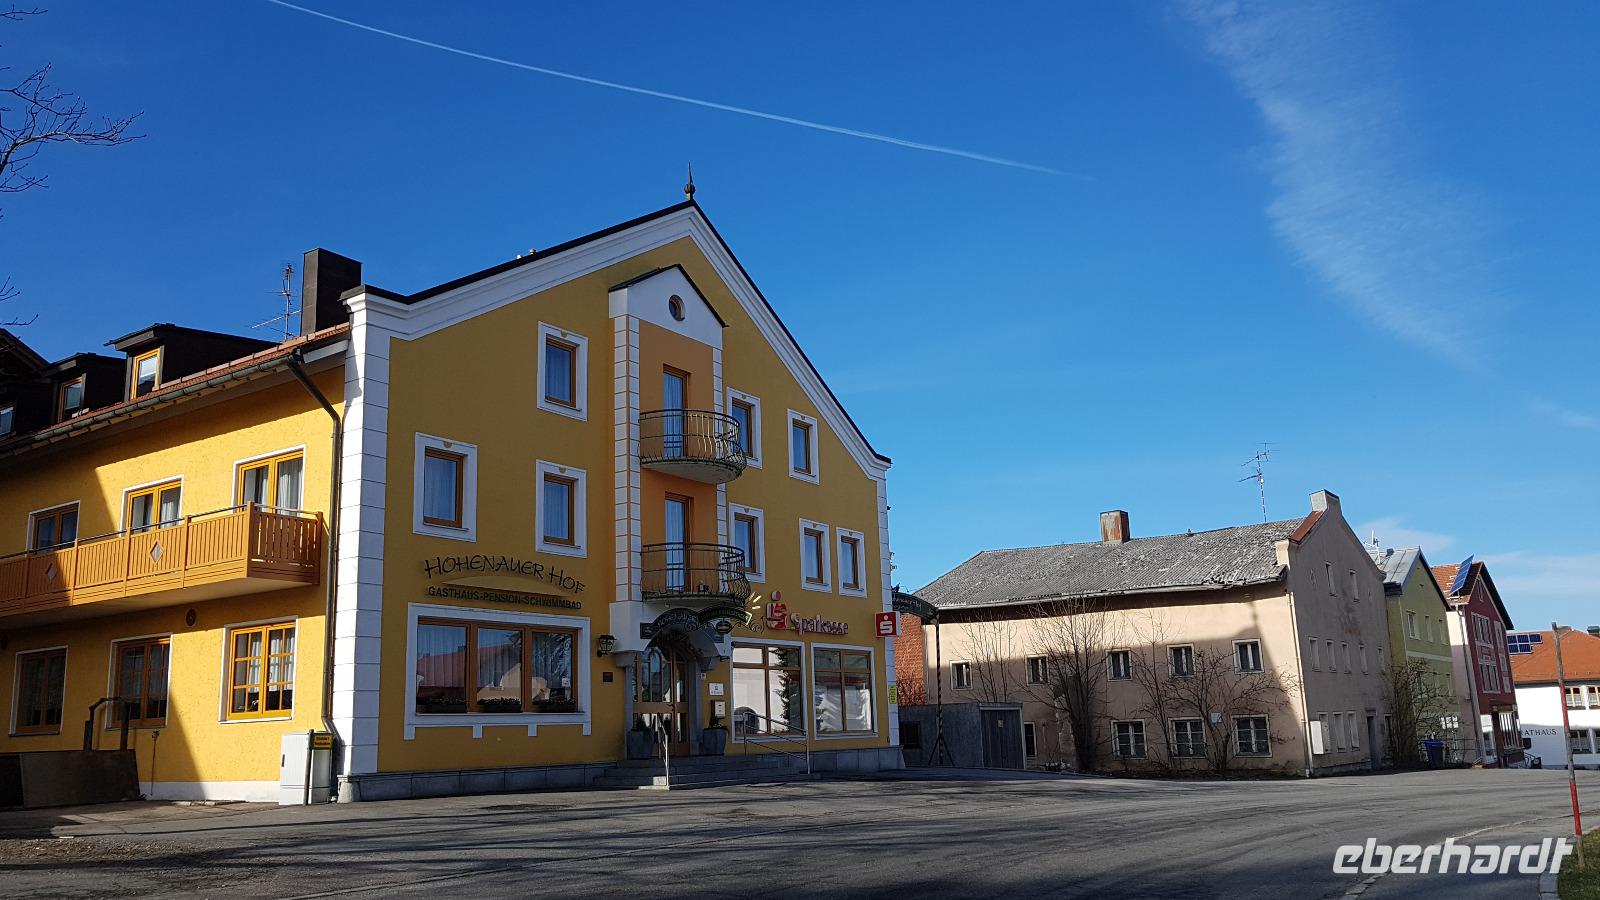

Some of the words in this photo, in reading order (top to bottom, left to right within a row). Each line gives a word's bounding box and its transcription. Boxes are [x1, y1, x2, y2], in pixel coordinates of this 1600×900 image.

[424, 554, 545, 580] HOHENAUER
[548, 565, 586, 594] HOF
[790, 611, 849, 636] Sparkasse
